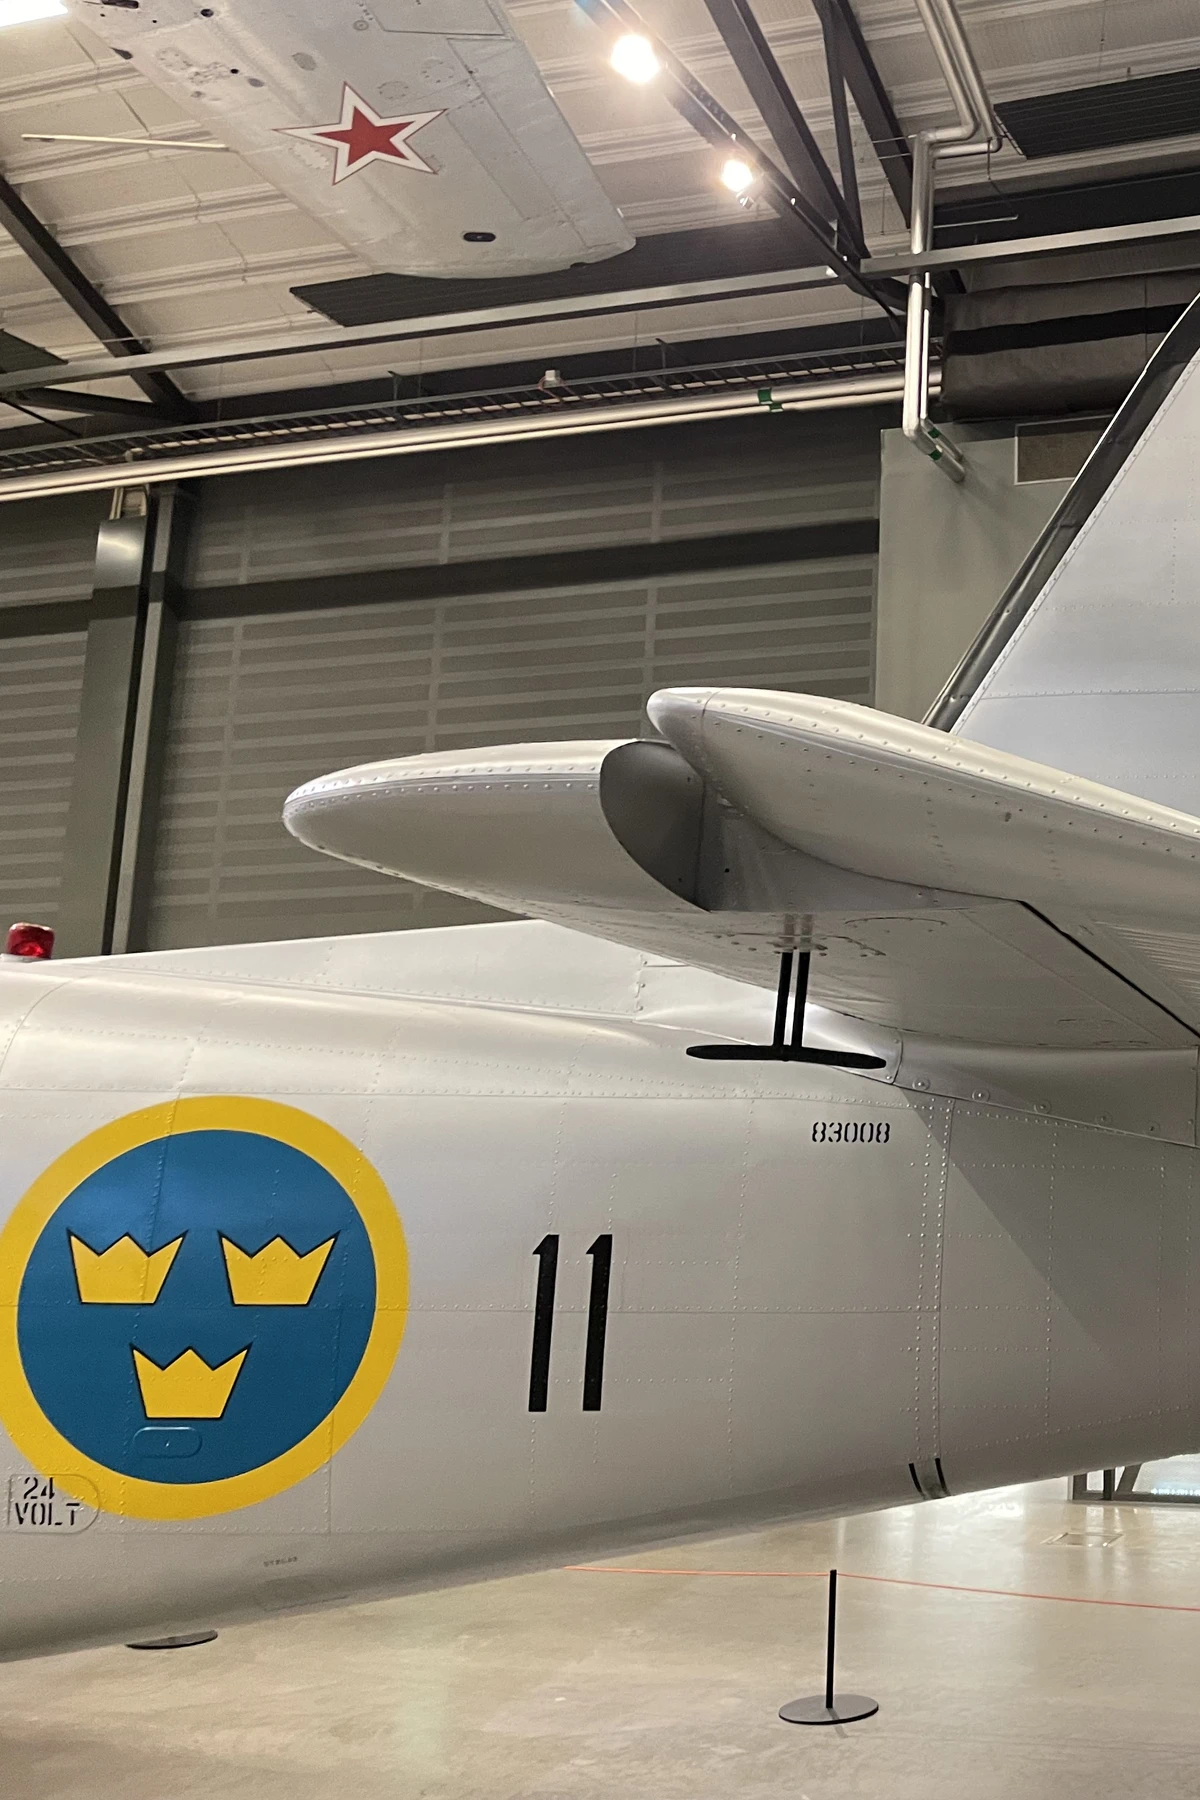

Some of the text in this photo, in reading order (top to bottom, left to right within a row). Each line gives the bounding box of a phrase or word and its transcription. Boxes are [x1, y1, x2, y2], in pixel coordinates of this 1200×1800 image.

[812, 1121, 890, 1143] 83008
[528, 1234, 612, 1411] 11
[23, 1477, 55, 1499] 24
[15, 1502, 80, 1525] VOLT
